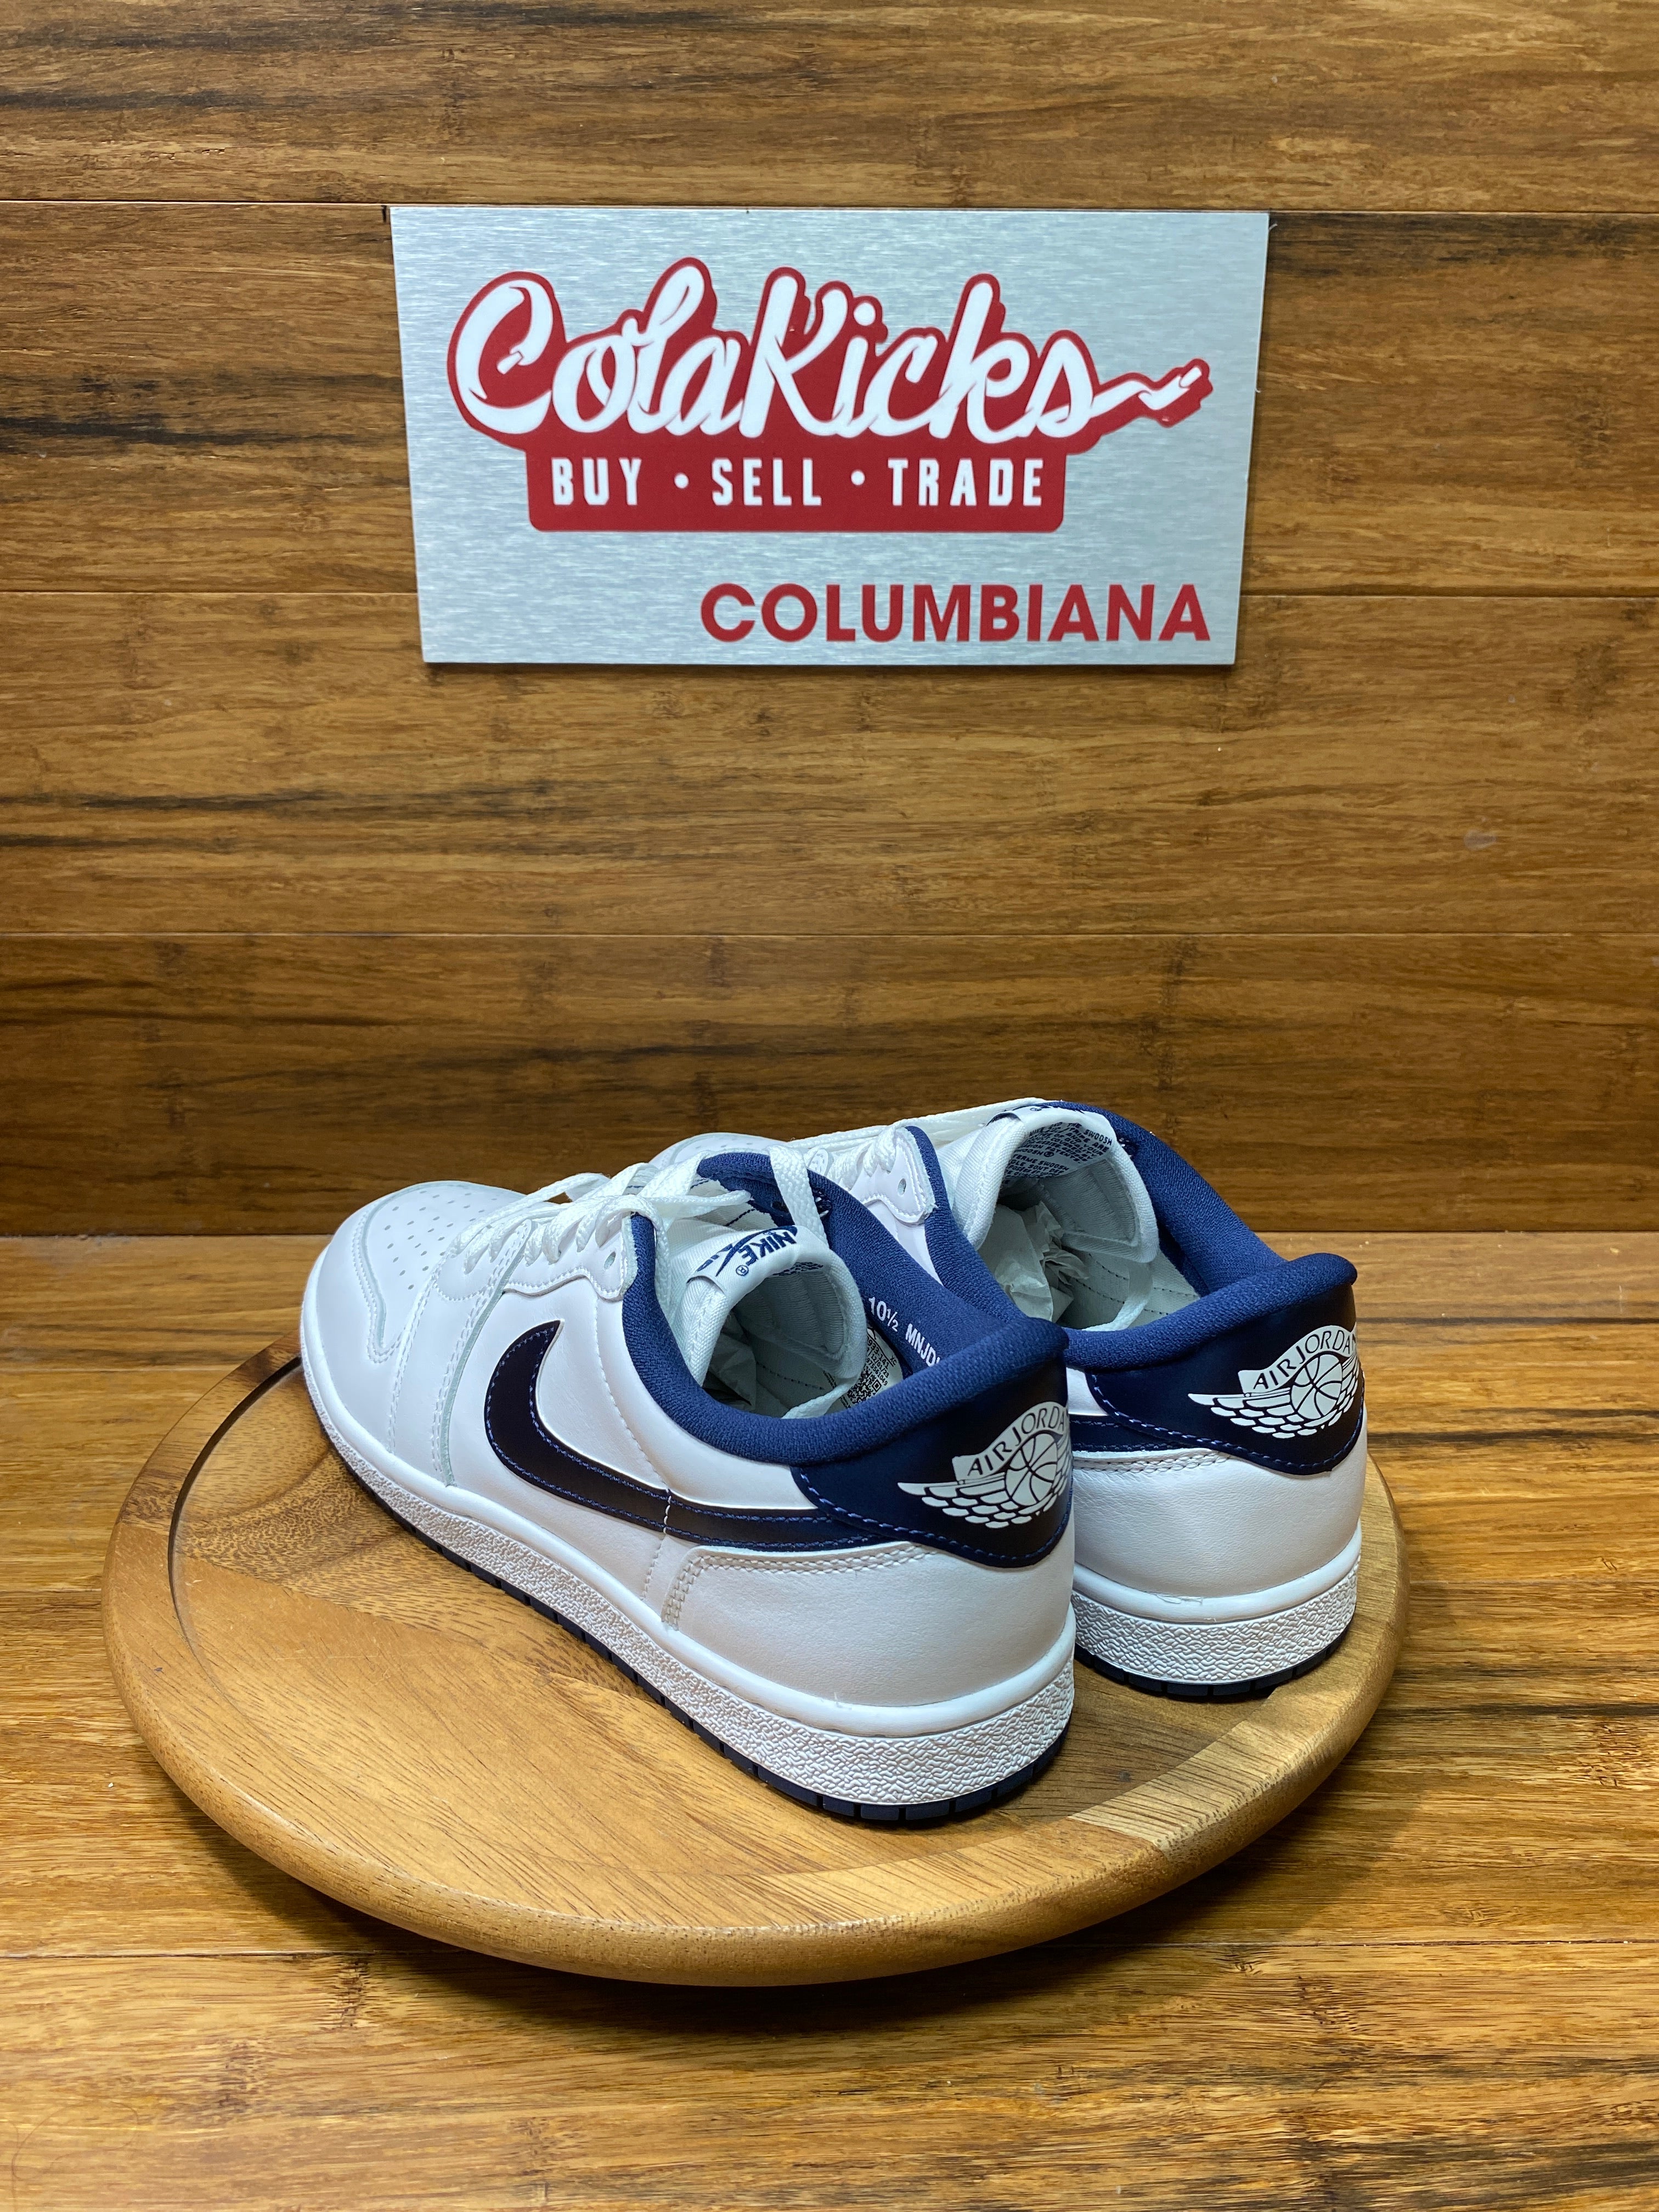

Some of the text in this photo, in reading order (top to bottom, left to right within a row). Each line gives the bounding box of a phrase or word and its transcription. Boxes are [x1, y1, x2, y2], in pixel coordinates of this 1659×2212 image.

[454, 262, 1203, 444] ColaKicks
[552, 457, 1043, 506] BUY SELL TRADE
[701, 583, 1210, 642] COLUMBIANA
[1084, 1129, 1113, 1146] SWOOSH
[737, 1231, 797, 1266] NIKE
[867, 1337, 890, 1369] 933-141
[1253, 1358, 1297, 1390] AIR
[967, 1406, 1068, 1476] AIR JORDA
